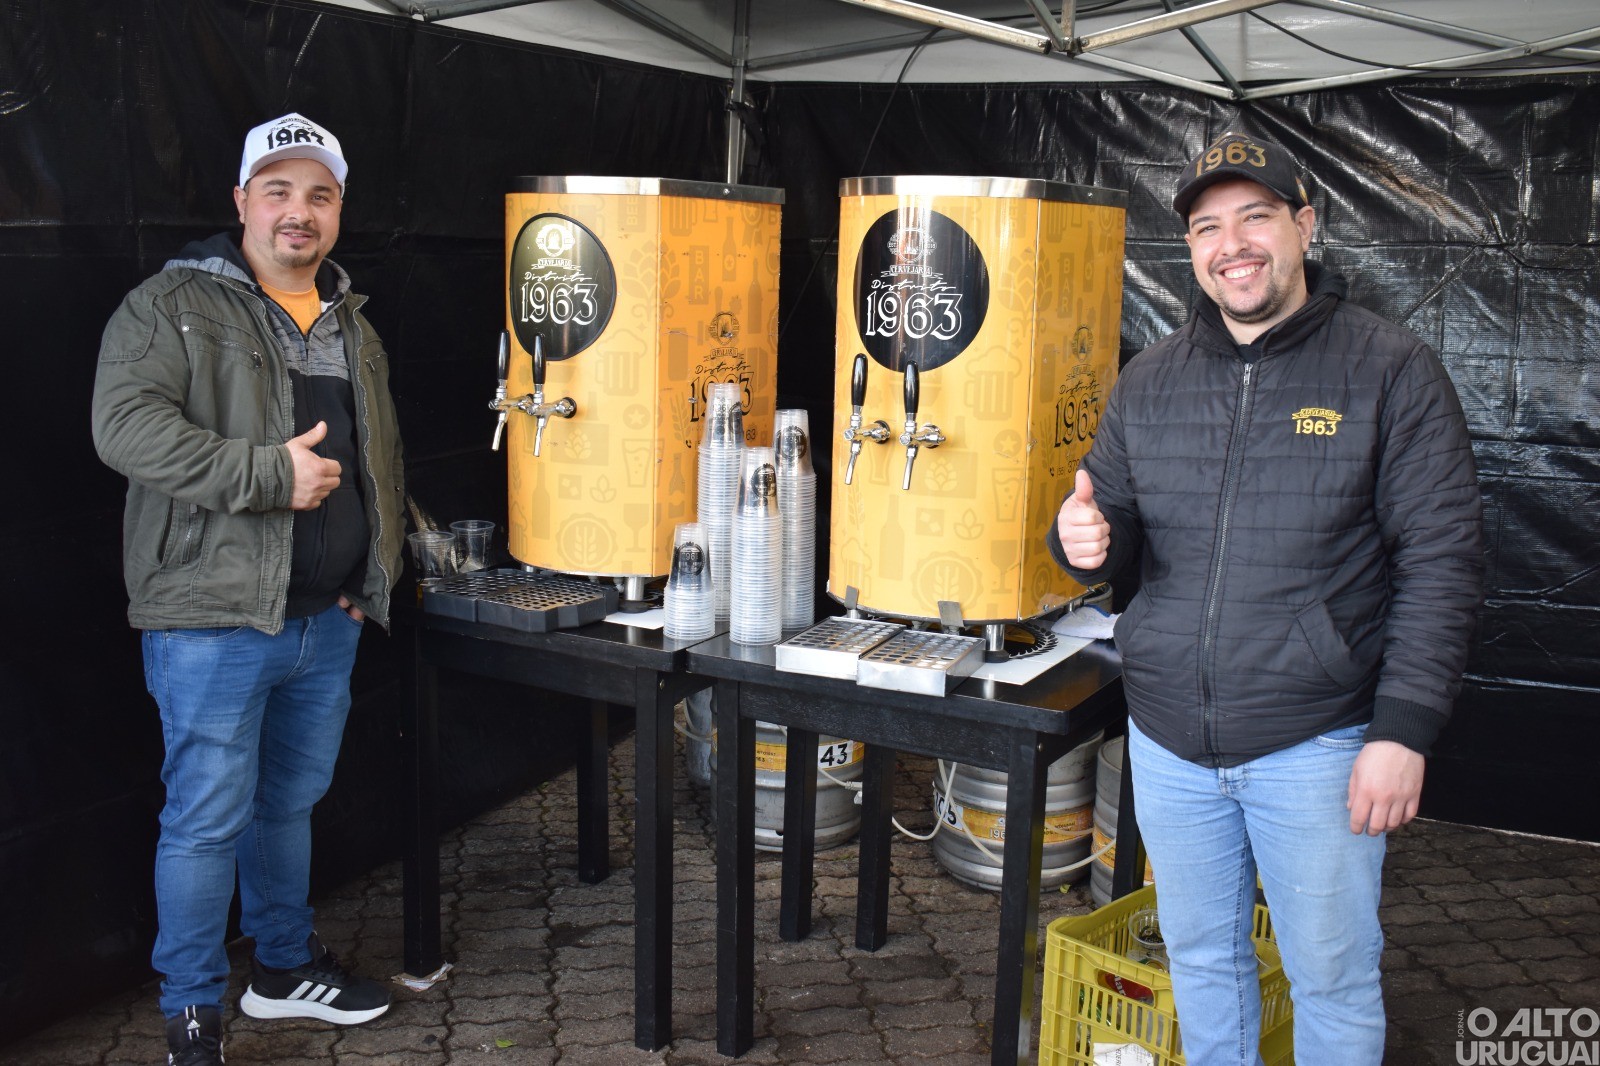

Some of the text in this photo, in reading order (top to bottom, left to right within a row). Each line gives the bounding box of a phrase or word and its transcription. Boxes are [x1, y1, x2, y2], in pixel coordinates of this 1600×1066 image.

[1196, 142, 1266, 177] 1963
[524, 270, 593, 282] Distrito
[694, 250, 705, 300] BAR
[890, 265, 931, 275] CERVEJARIA
[870, 279, 956, 291] Distrito
[1062, 257, 1073, 313] BAR
[521, 281, 598, 326] 1963
[865, 290, 963, 340] 1963
[694, 361, 752, 375] Distrito
[1059, 378, 1101, 395] Distrito
[1054, 391, 1102, 448] 1963
[1295, 419, 1337, 436] 1963
[820, 743, 848, 766] 43
